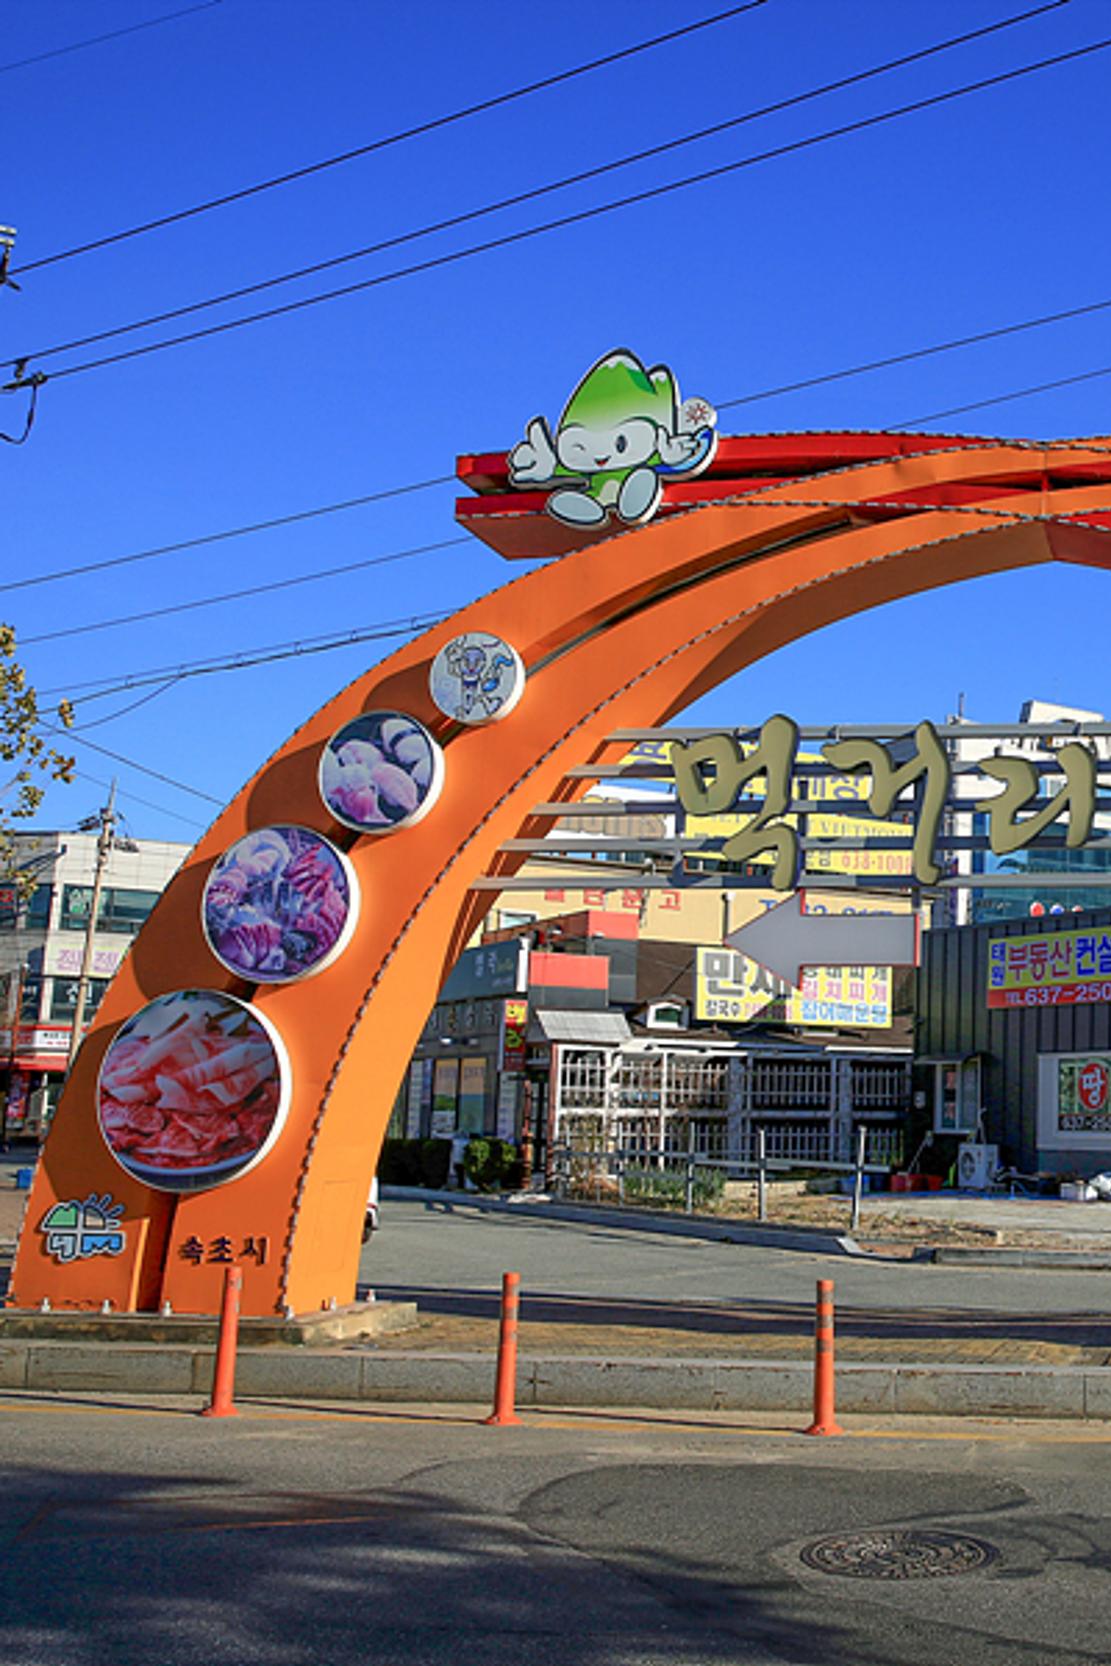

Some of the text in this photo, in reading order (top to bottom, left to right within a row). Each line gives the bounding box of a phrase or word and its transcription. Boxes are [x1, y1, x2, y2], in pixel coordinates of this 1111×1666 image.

[1008, 940, 1072, 981] 부동산
[1082, 1066, 1105, 1106] 땅
[180, 1236, 270, 1266] 속초시
